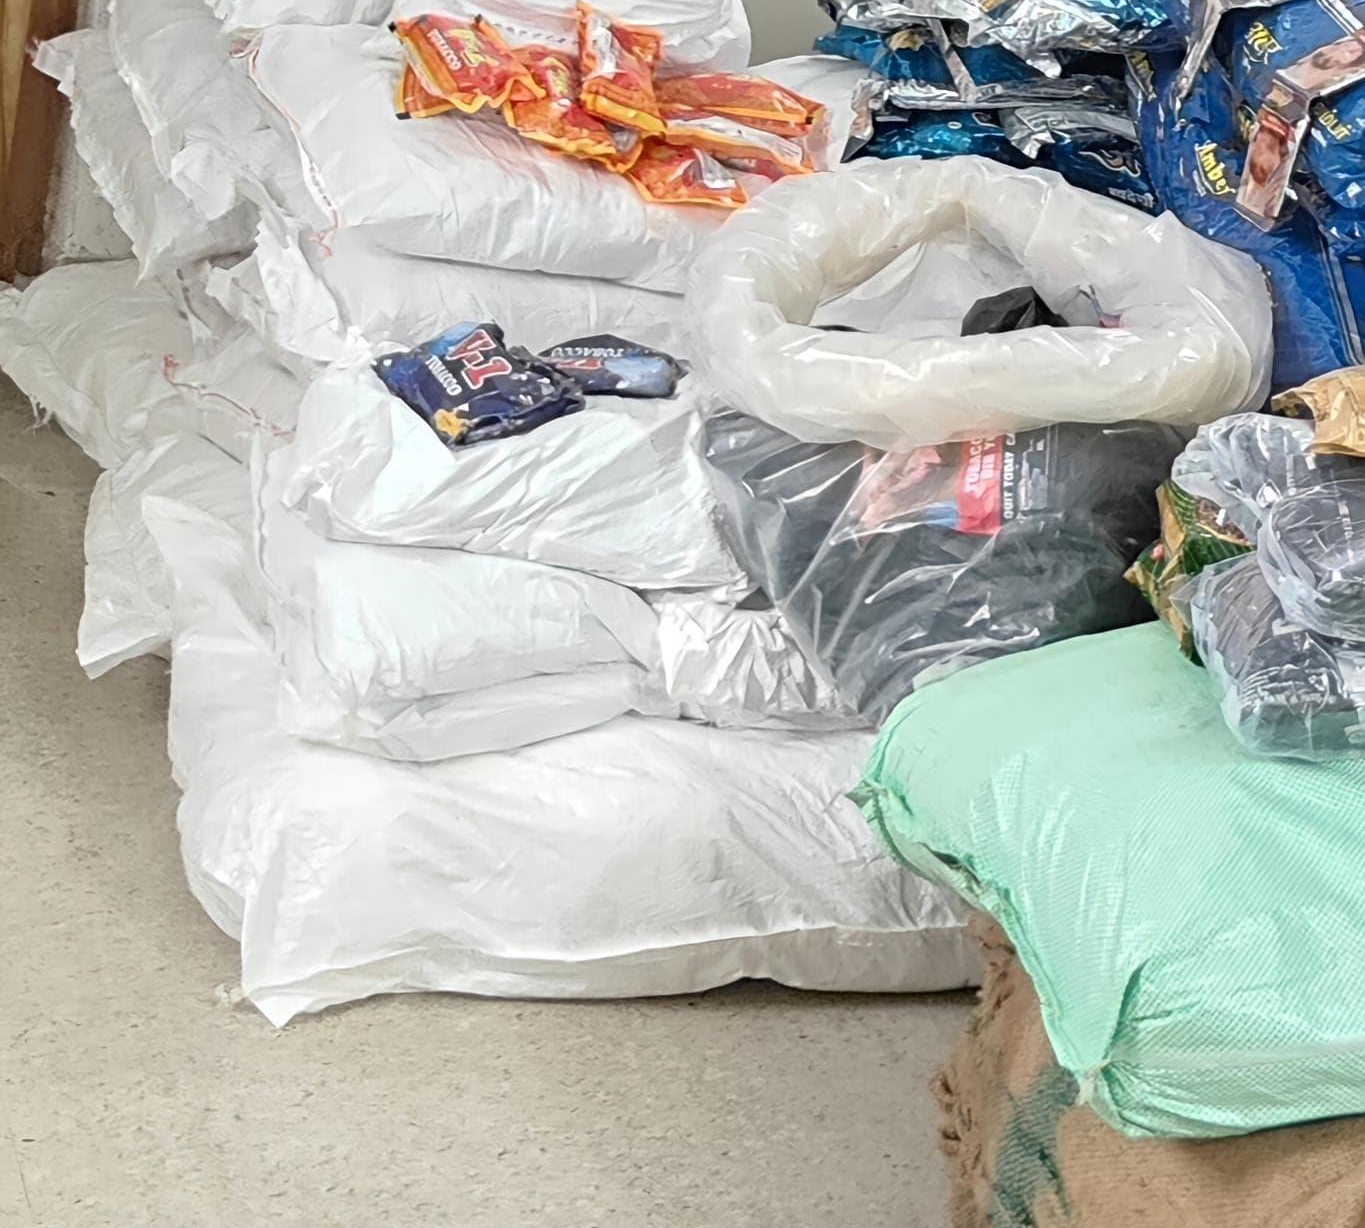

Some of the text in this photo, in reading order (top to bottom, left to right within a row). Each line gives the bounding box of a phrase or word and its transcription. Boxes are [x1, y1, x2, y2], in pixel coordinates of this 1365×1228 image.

[1196, 140, 1236, 196] Amber
[447, 329, 513, 391] V-1
[1003, 451, 1014, 489] TODAY
[1003, 490, 1014, 520] QUIT
